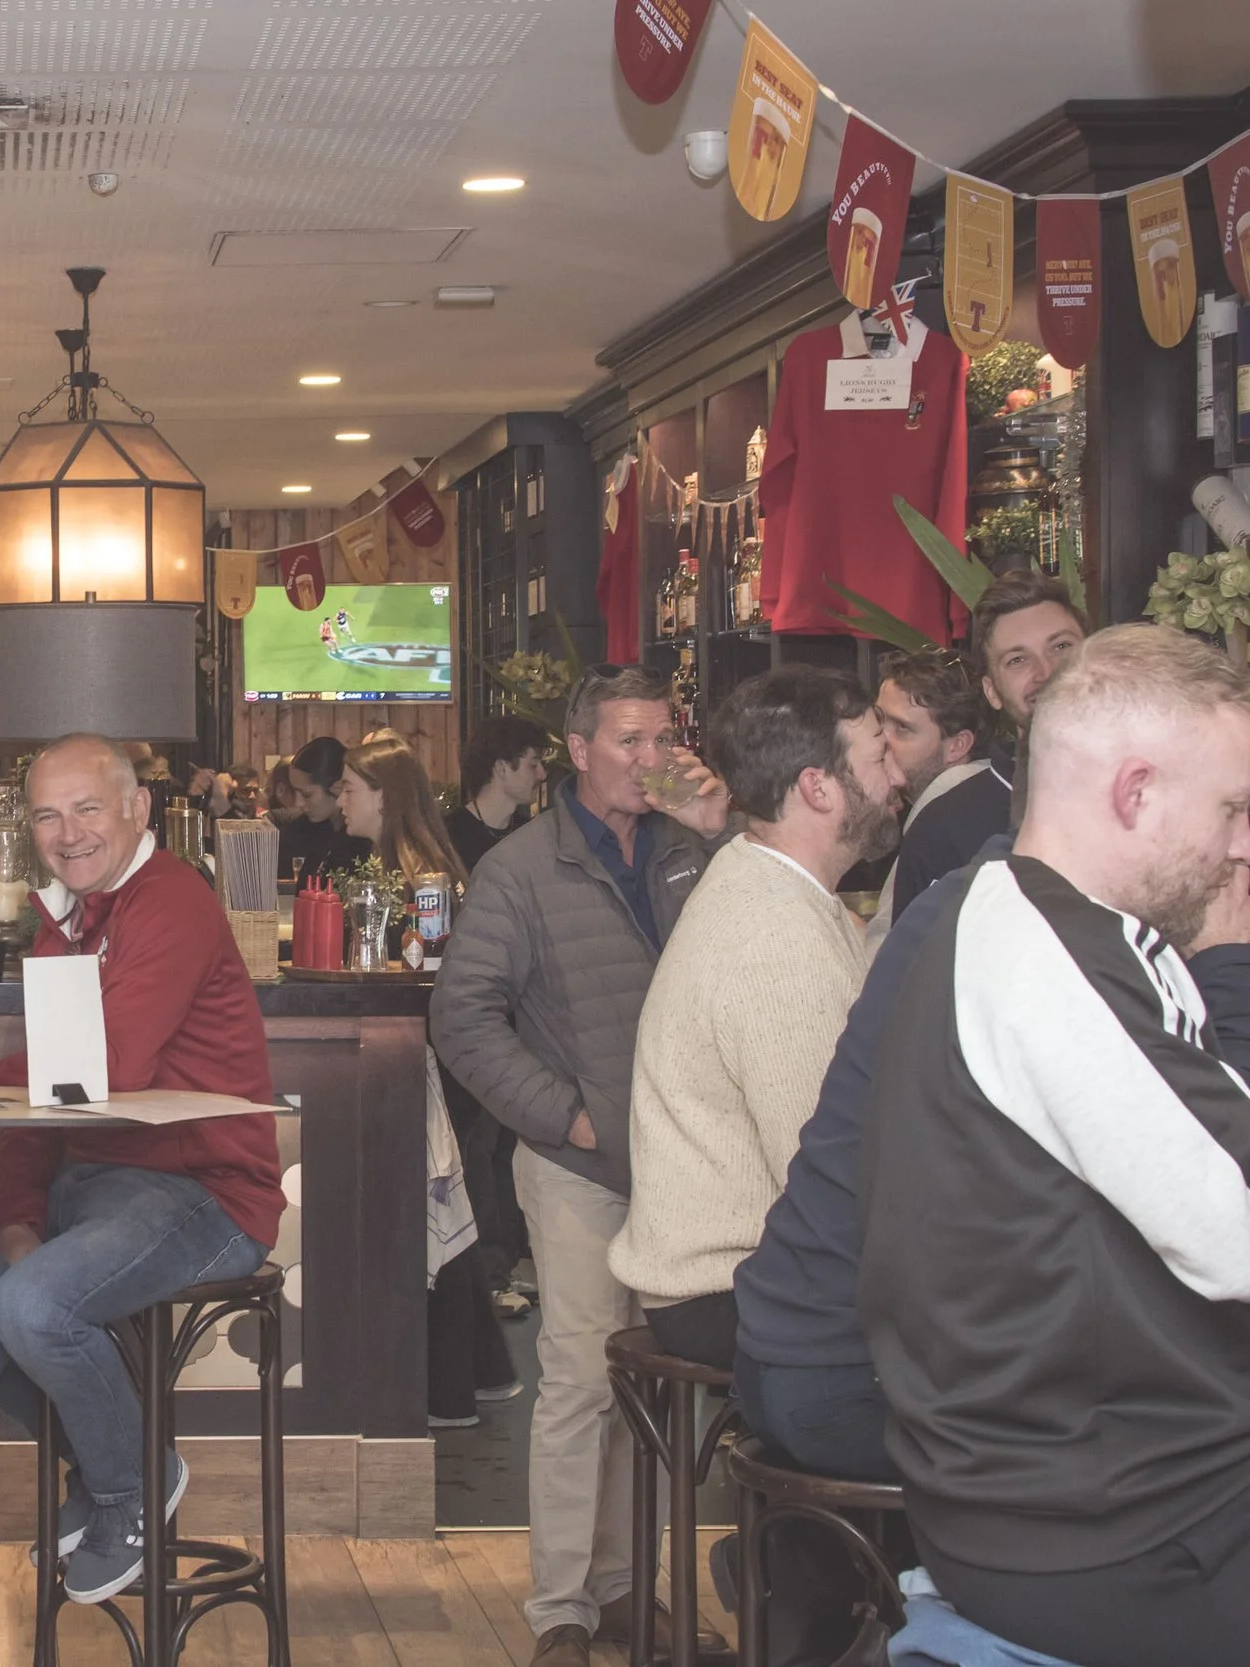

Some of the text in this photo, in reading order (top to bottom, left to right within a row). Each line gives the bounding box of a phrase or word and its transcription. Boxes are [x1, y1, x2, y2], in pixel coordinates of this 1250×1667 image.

[659, 16, 684, 52] UNDER
[831, 193, 852, 226] YOU
[1224, 220, 1233, 254] YOU
[971, 300, 986, 333] T
[418, 896, 438, 910] HP
